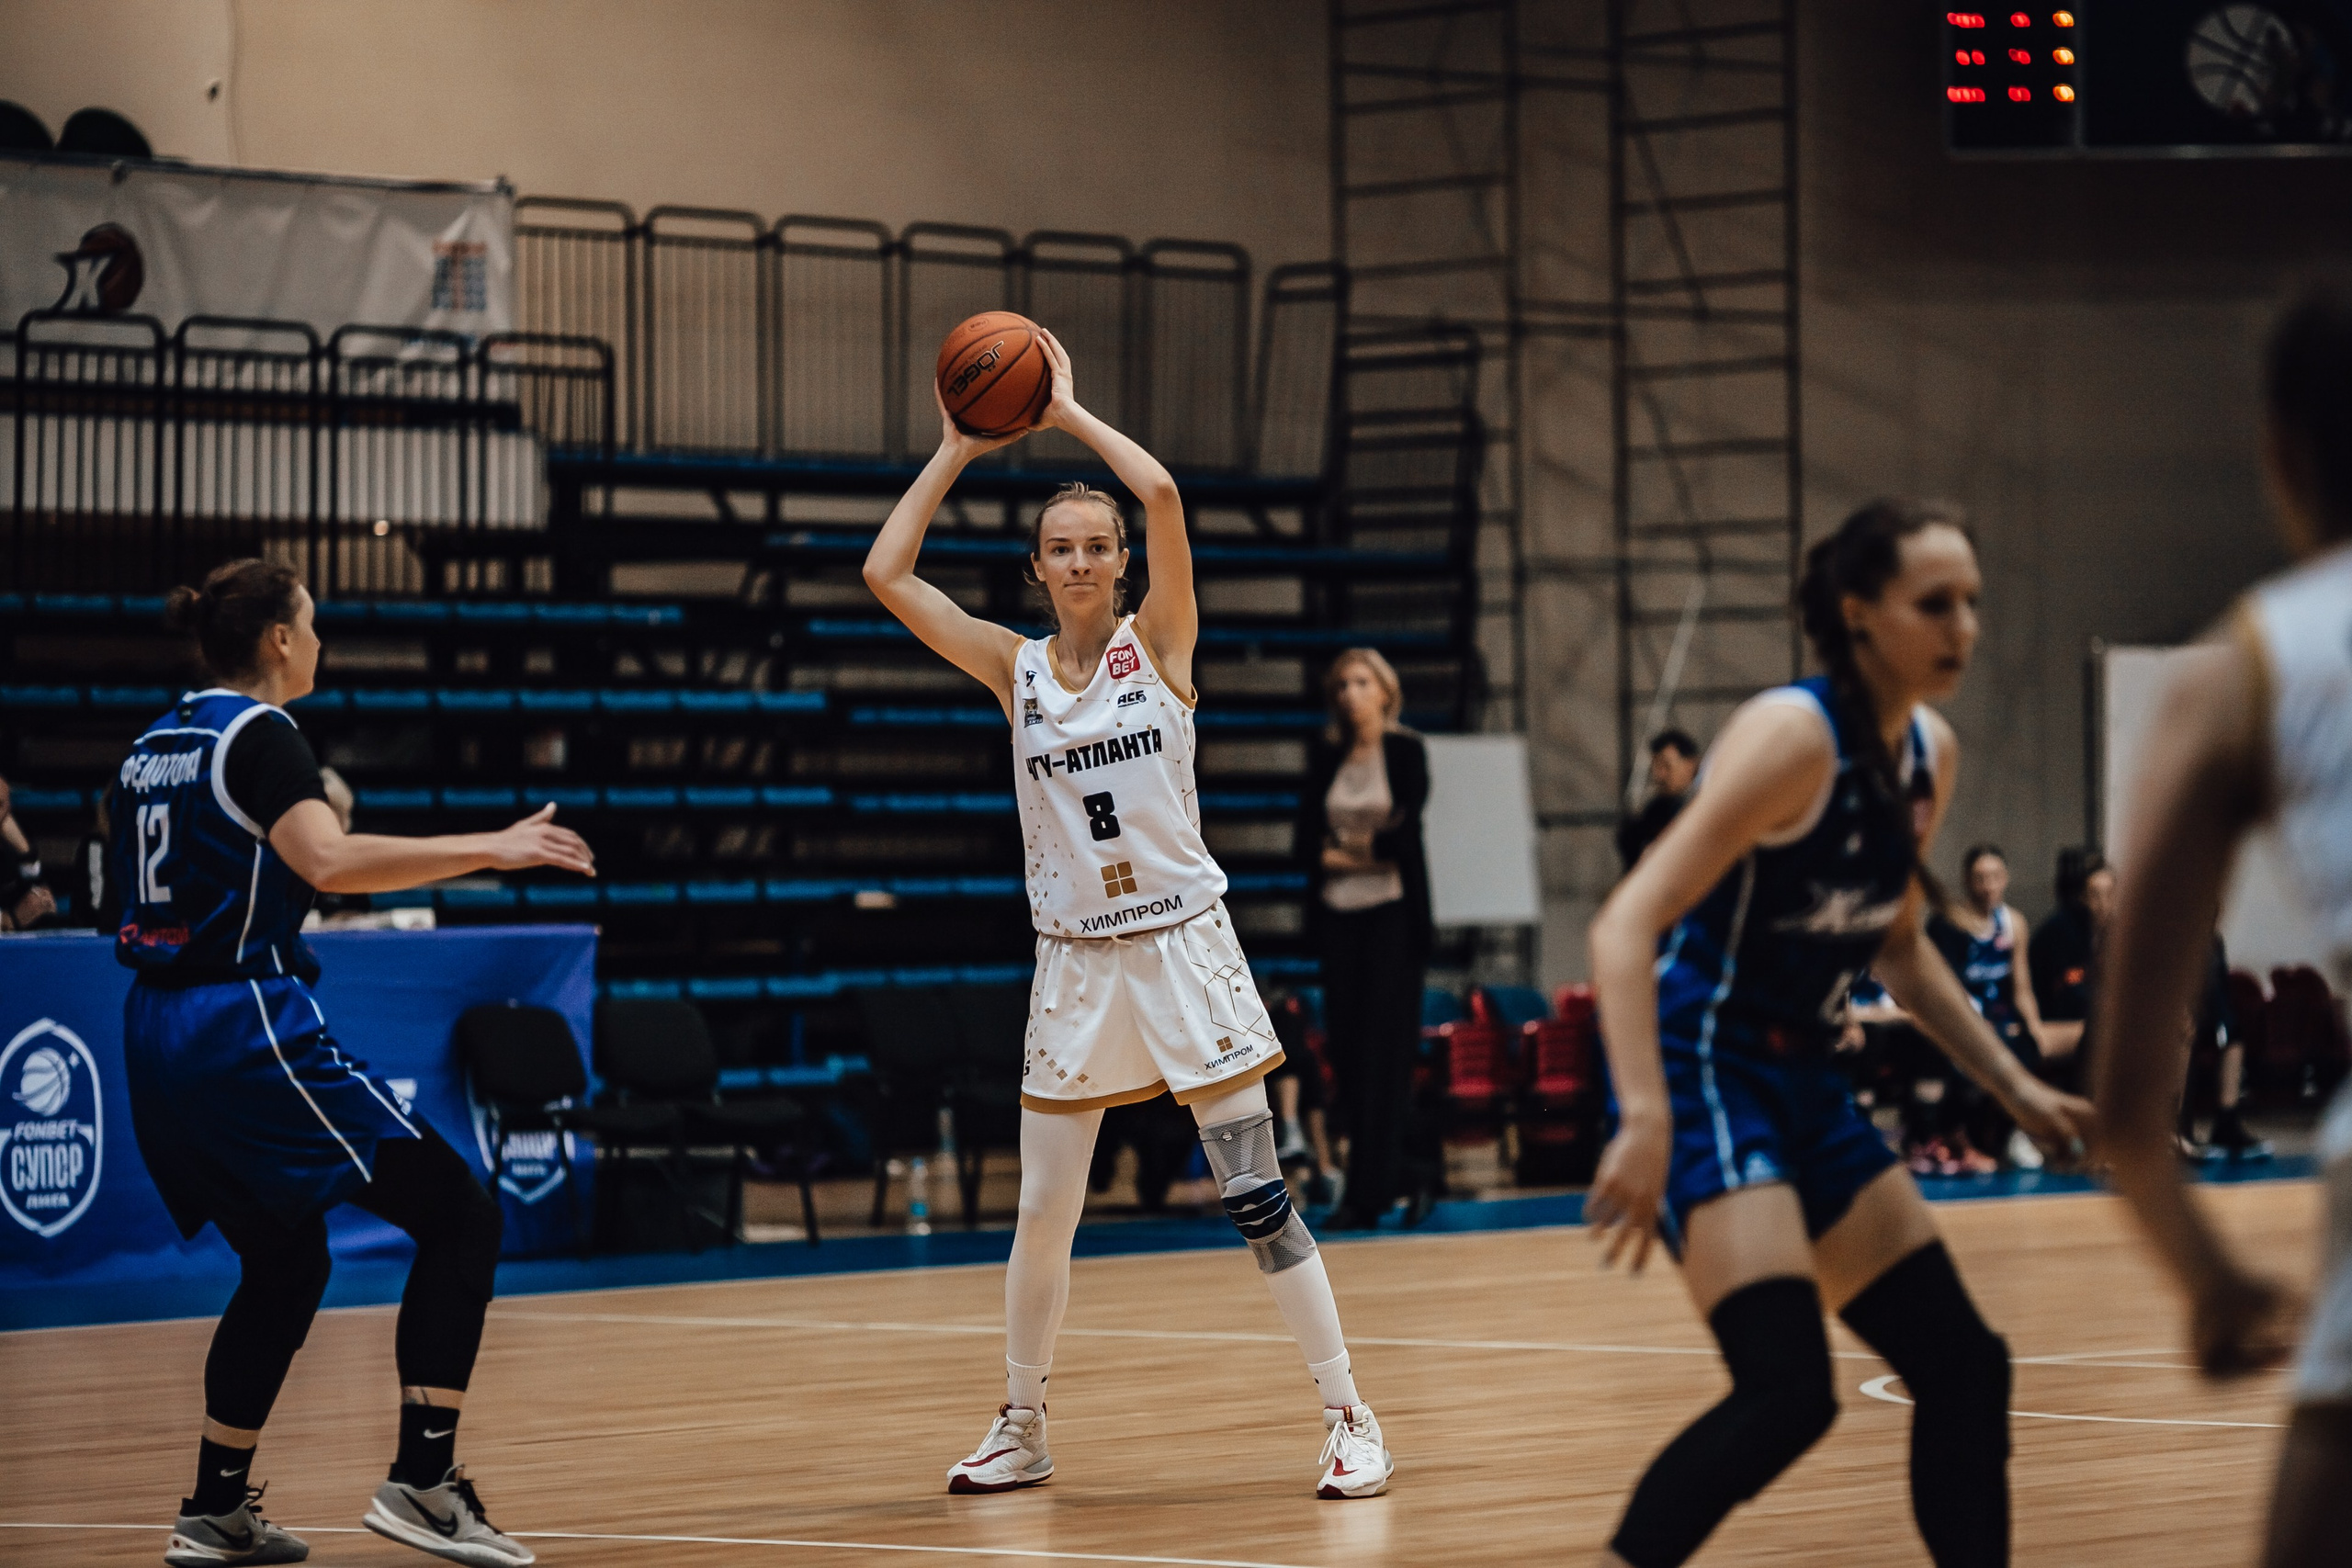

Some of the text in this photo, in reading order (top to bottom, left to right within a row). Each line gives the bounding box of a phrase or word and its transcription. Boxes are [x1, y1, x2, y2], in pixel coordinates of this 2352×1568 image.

[947, 340, 1004, 397] JÖGEL
[1109, 647, 1134, 664] FON
[1112, 656, 1137, 676] BET
[1082, 791, 1121, 841] 8
[136, 803, 172, 904] 12
[1080, 895, 1183, 933] ХИМПРОМ
[1204, 1044, 1254, 1070] ХИМПРОМ
[14, 1119, 78, 1141] FONBET
